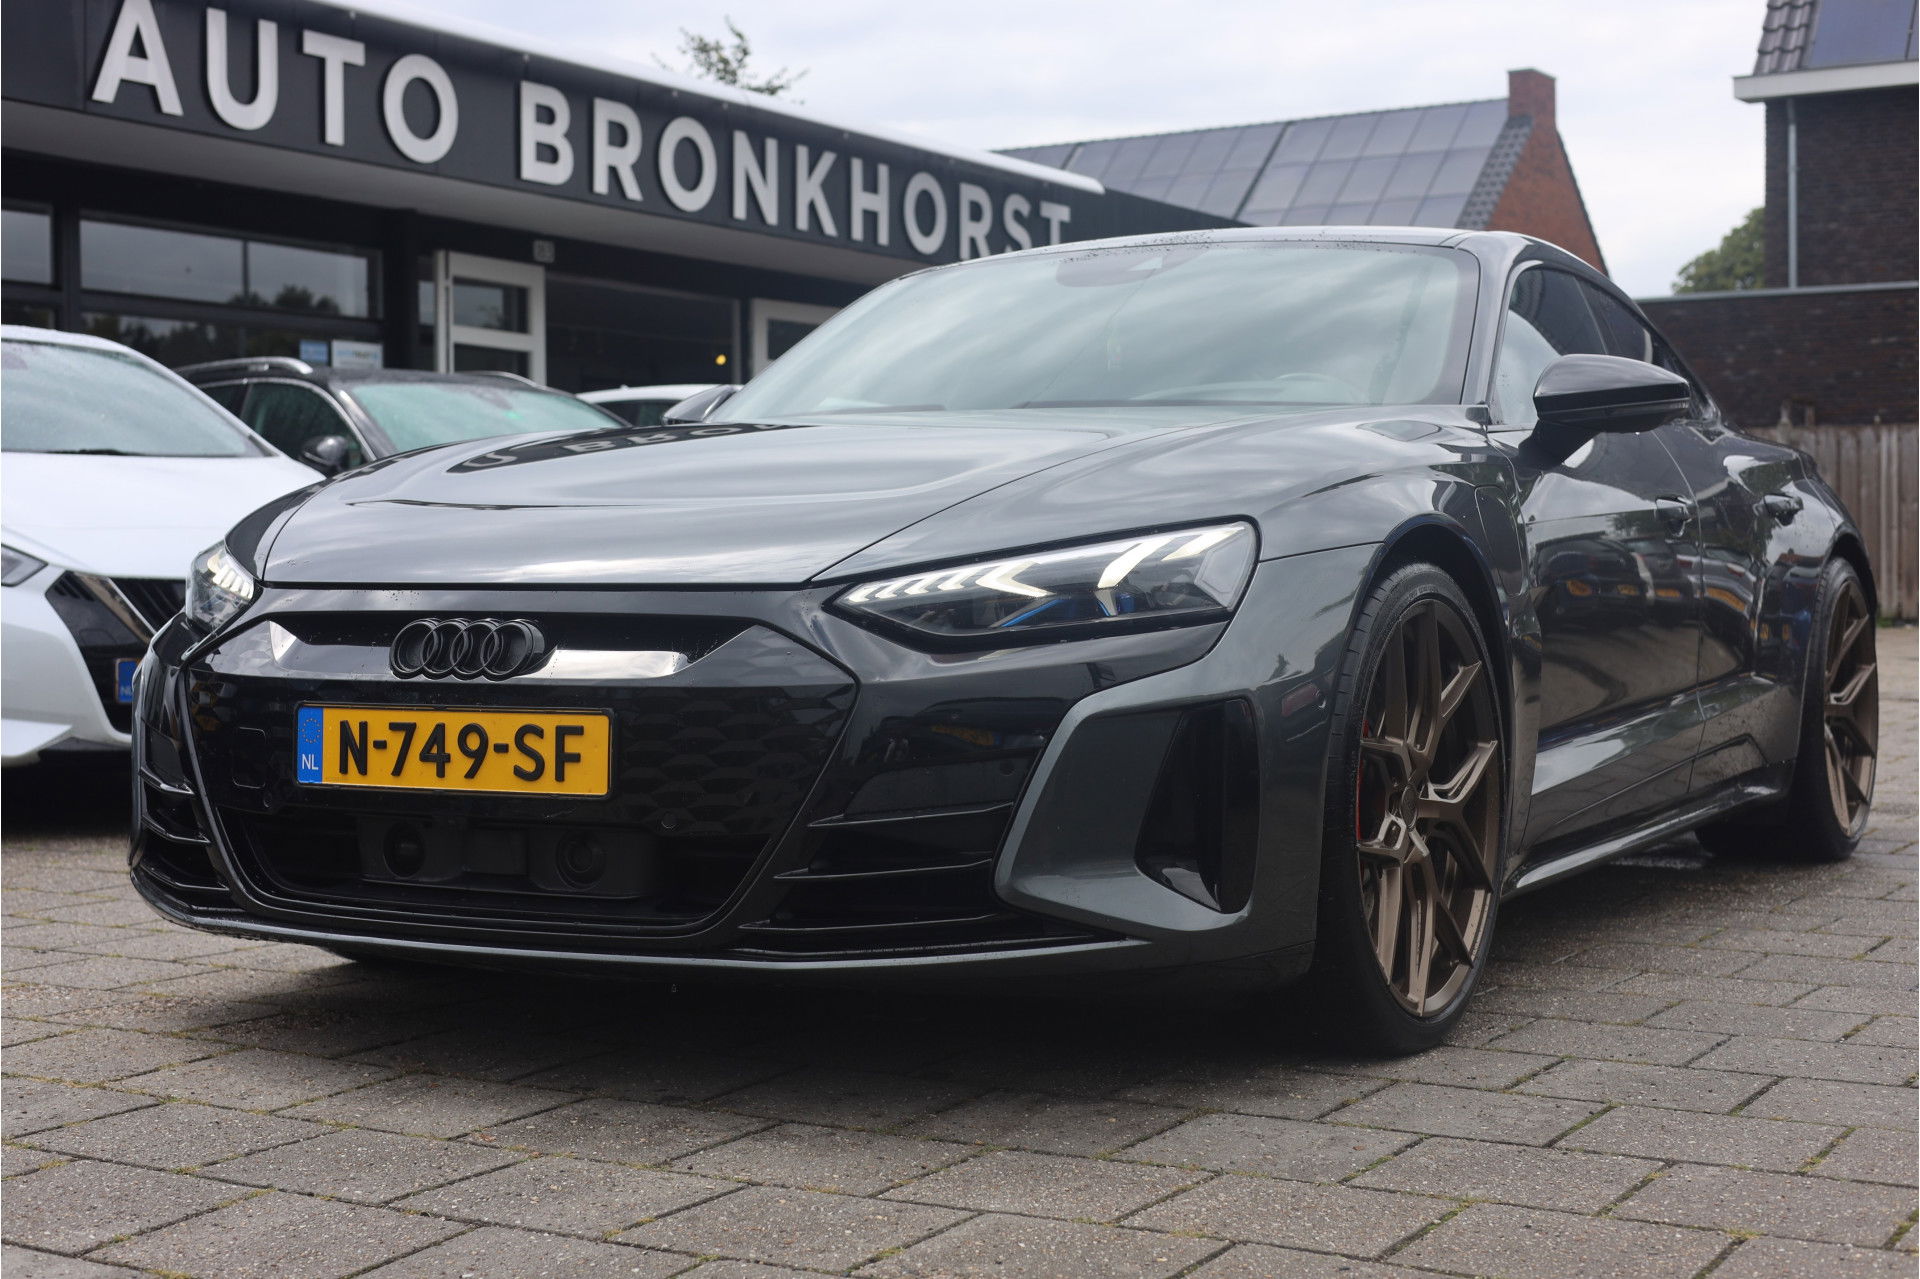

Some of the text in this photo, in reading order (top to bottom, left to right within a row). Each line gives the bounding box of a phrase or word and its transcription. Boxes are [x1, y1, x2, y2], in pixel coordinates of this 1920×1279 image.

[92, 0, 1071, 259] AUTO BRONKHORST
[301, 754, 319, 770] NL
[339, 720, 584, 782] N-749-SF
